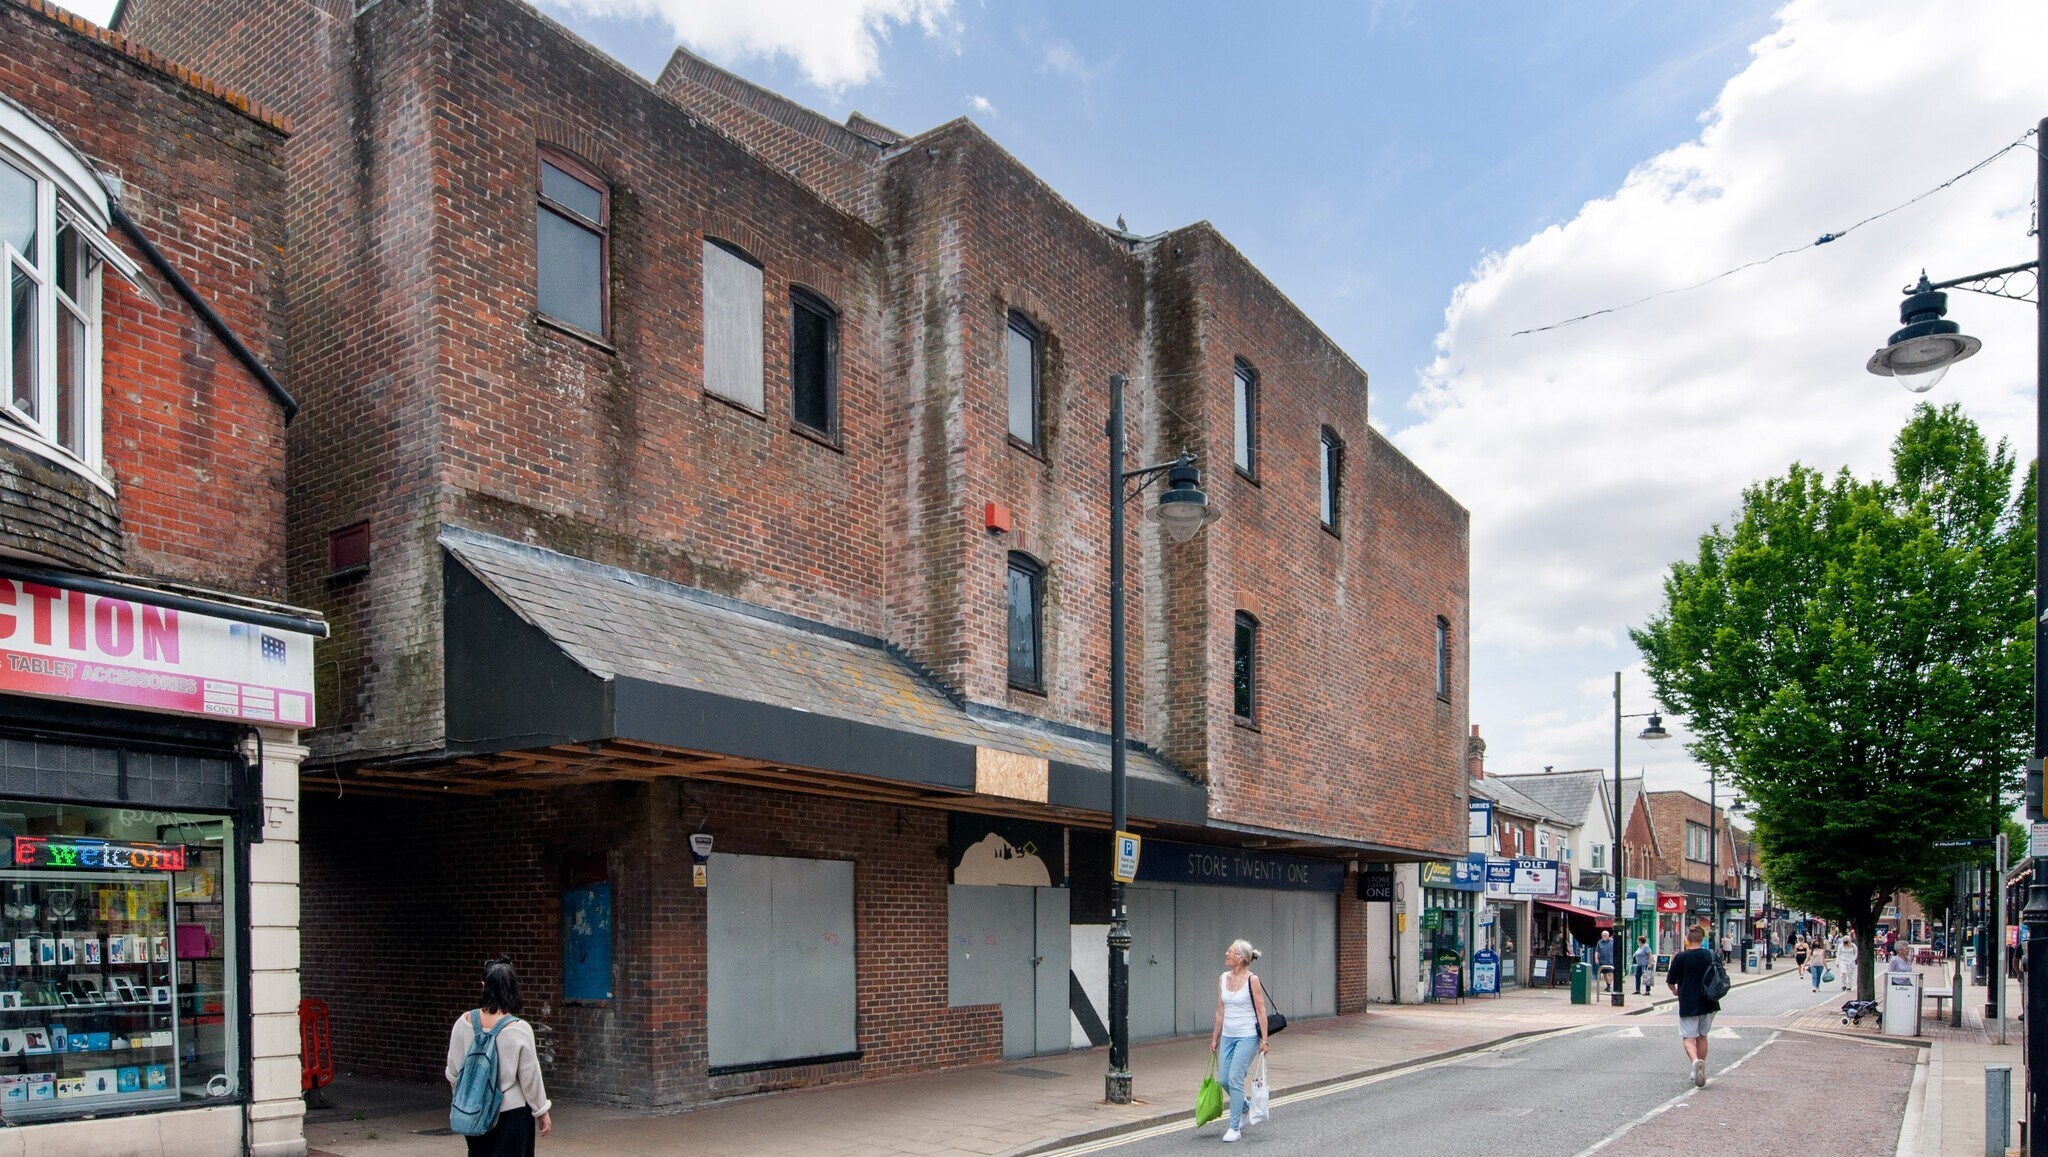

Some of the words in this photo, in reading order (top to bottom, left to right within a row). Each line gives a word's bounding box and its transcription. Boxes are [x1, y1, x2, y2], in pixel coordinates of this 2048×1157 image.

[7, 654, 77, 679] TABLET
[82, 665, 197, 695] ACCESSORIES
[205, 703, 237, 715] SONY
[1126, 842, 1132, 854] P
[1187, 853, 1227, 877] STORE
[1233, 857, 1283, 881] TWENTY
[1287, 863, 1308, 883] ONE
[1456, 862, 1468, 872] MAX
[1532, 861, 1548, 869] LET
[1366, 887, 1391, 897] ONE
